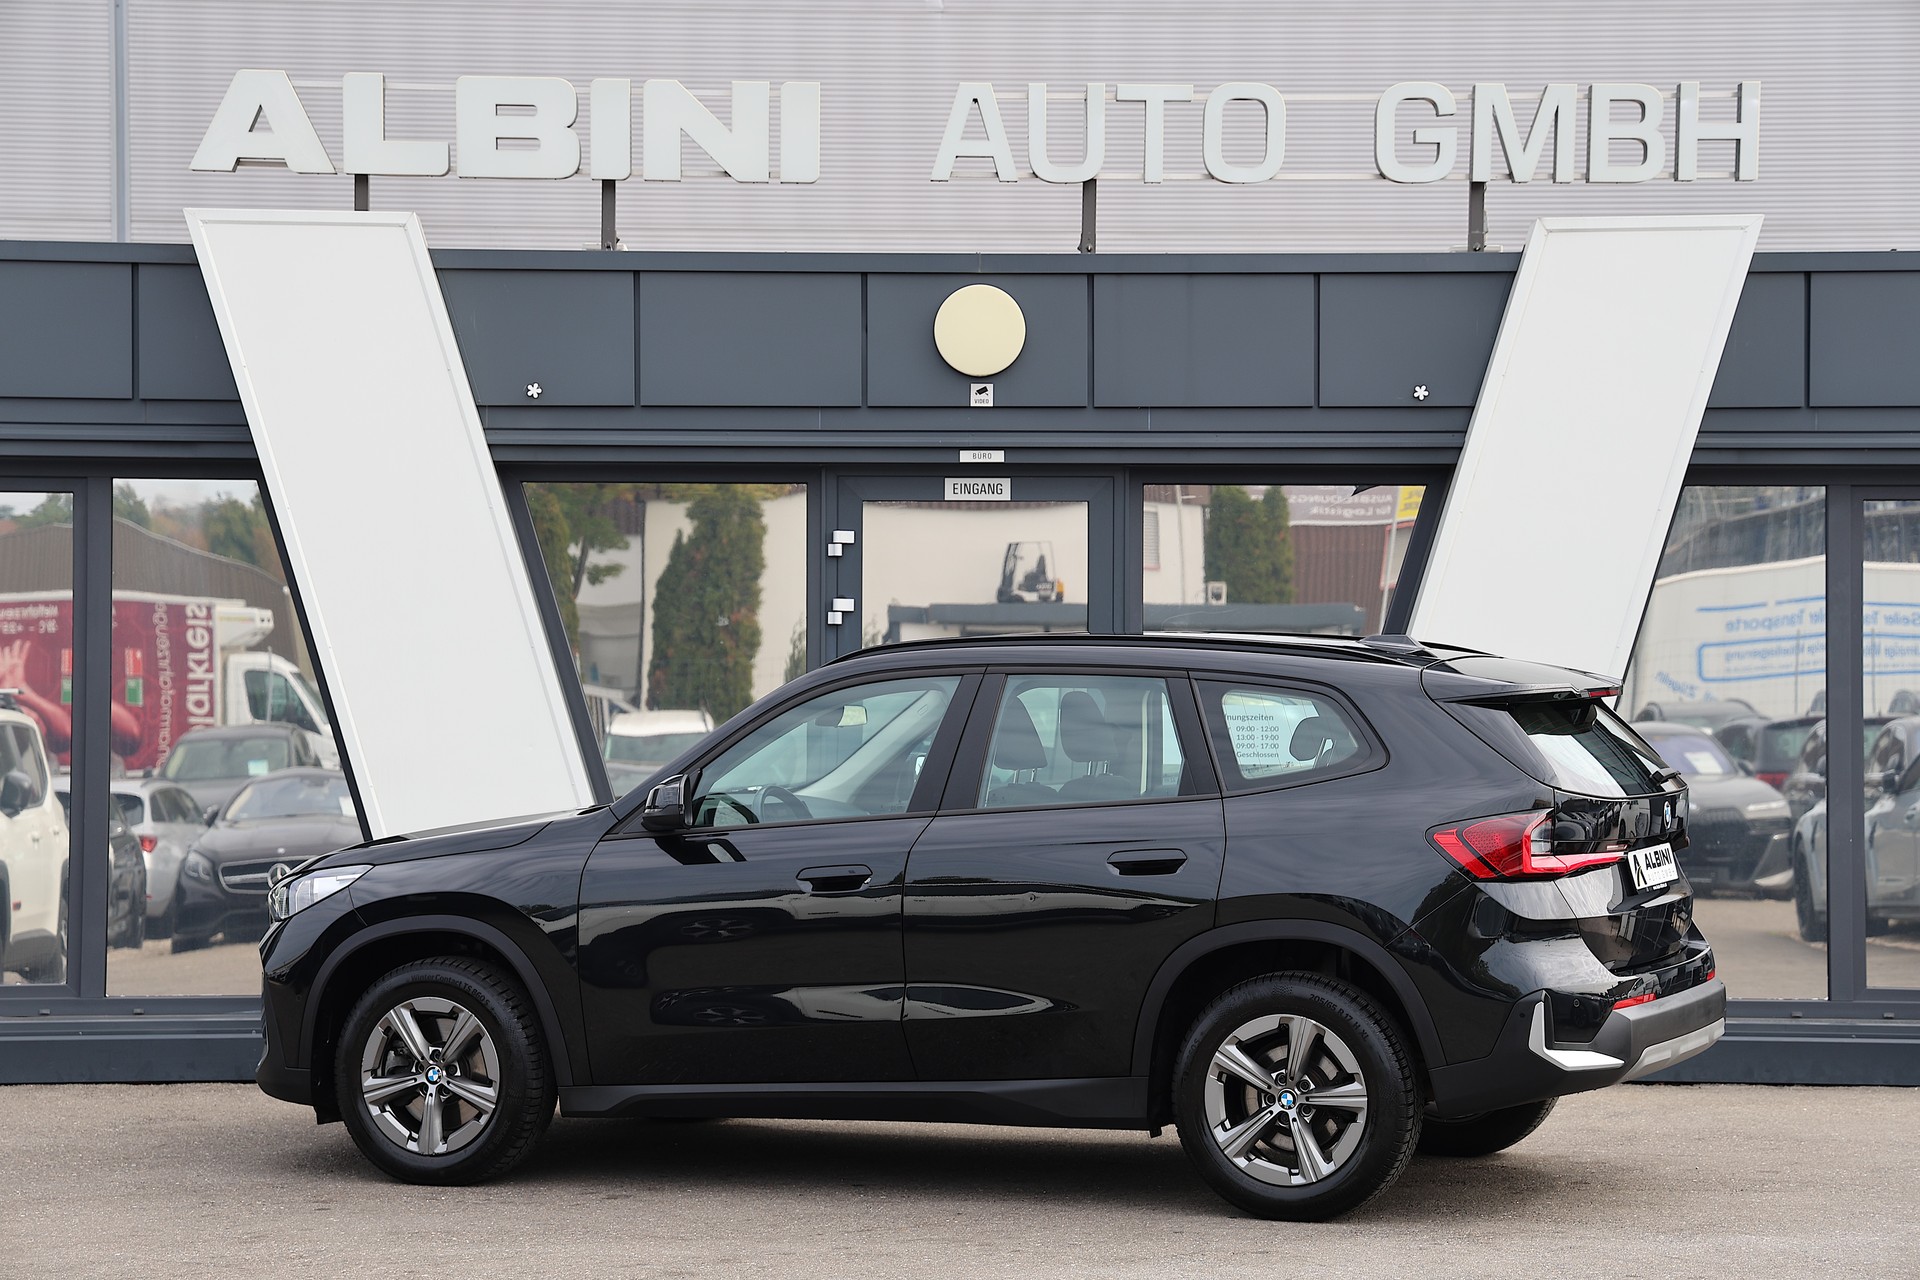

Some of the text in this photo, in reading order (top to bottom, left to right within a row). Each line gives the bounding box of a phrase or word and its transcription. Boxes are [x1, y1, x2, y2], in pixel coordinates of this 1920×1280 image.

[189, 69, 1761, 184] ALBINI AUTO GMBH
[972, 452, 992, 460] BÜRO
[952, 482, 1003, 496] EINGANG
[1226, 713, 1274, 722] nungszeiten
[1644, 847, 1672, 870] ALBINI
[463, 982, 472, 992] TS
[472, 988, 486, 1002] 860
[1309, 993, 1369, 1041] 205/65 R 17 H XL
